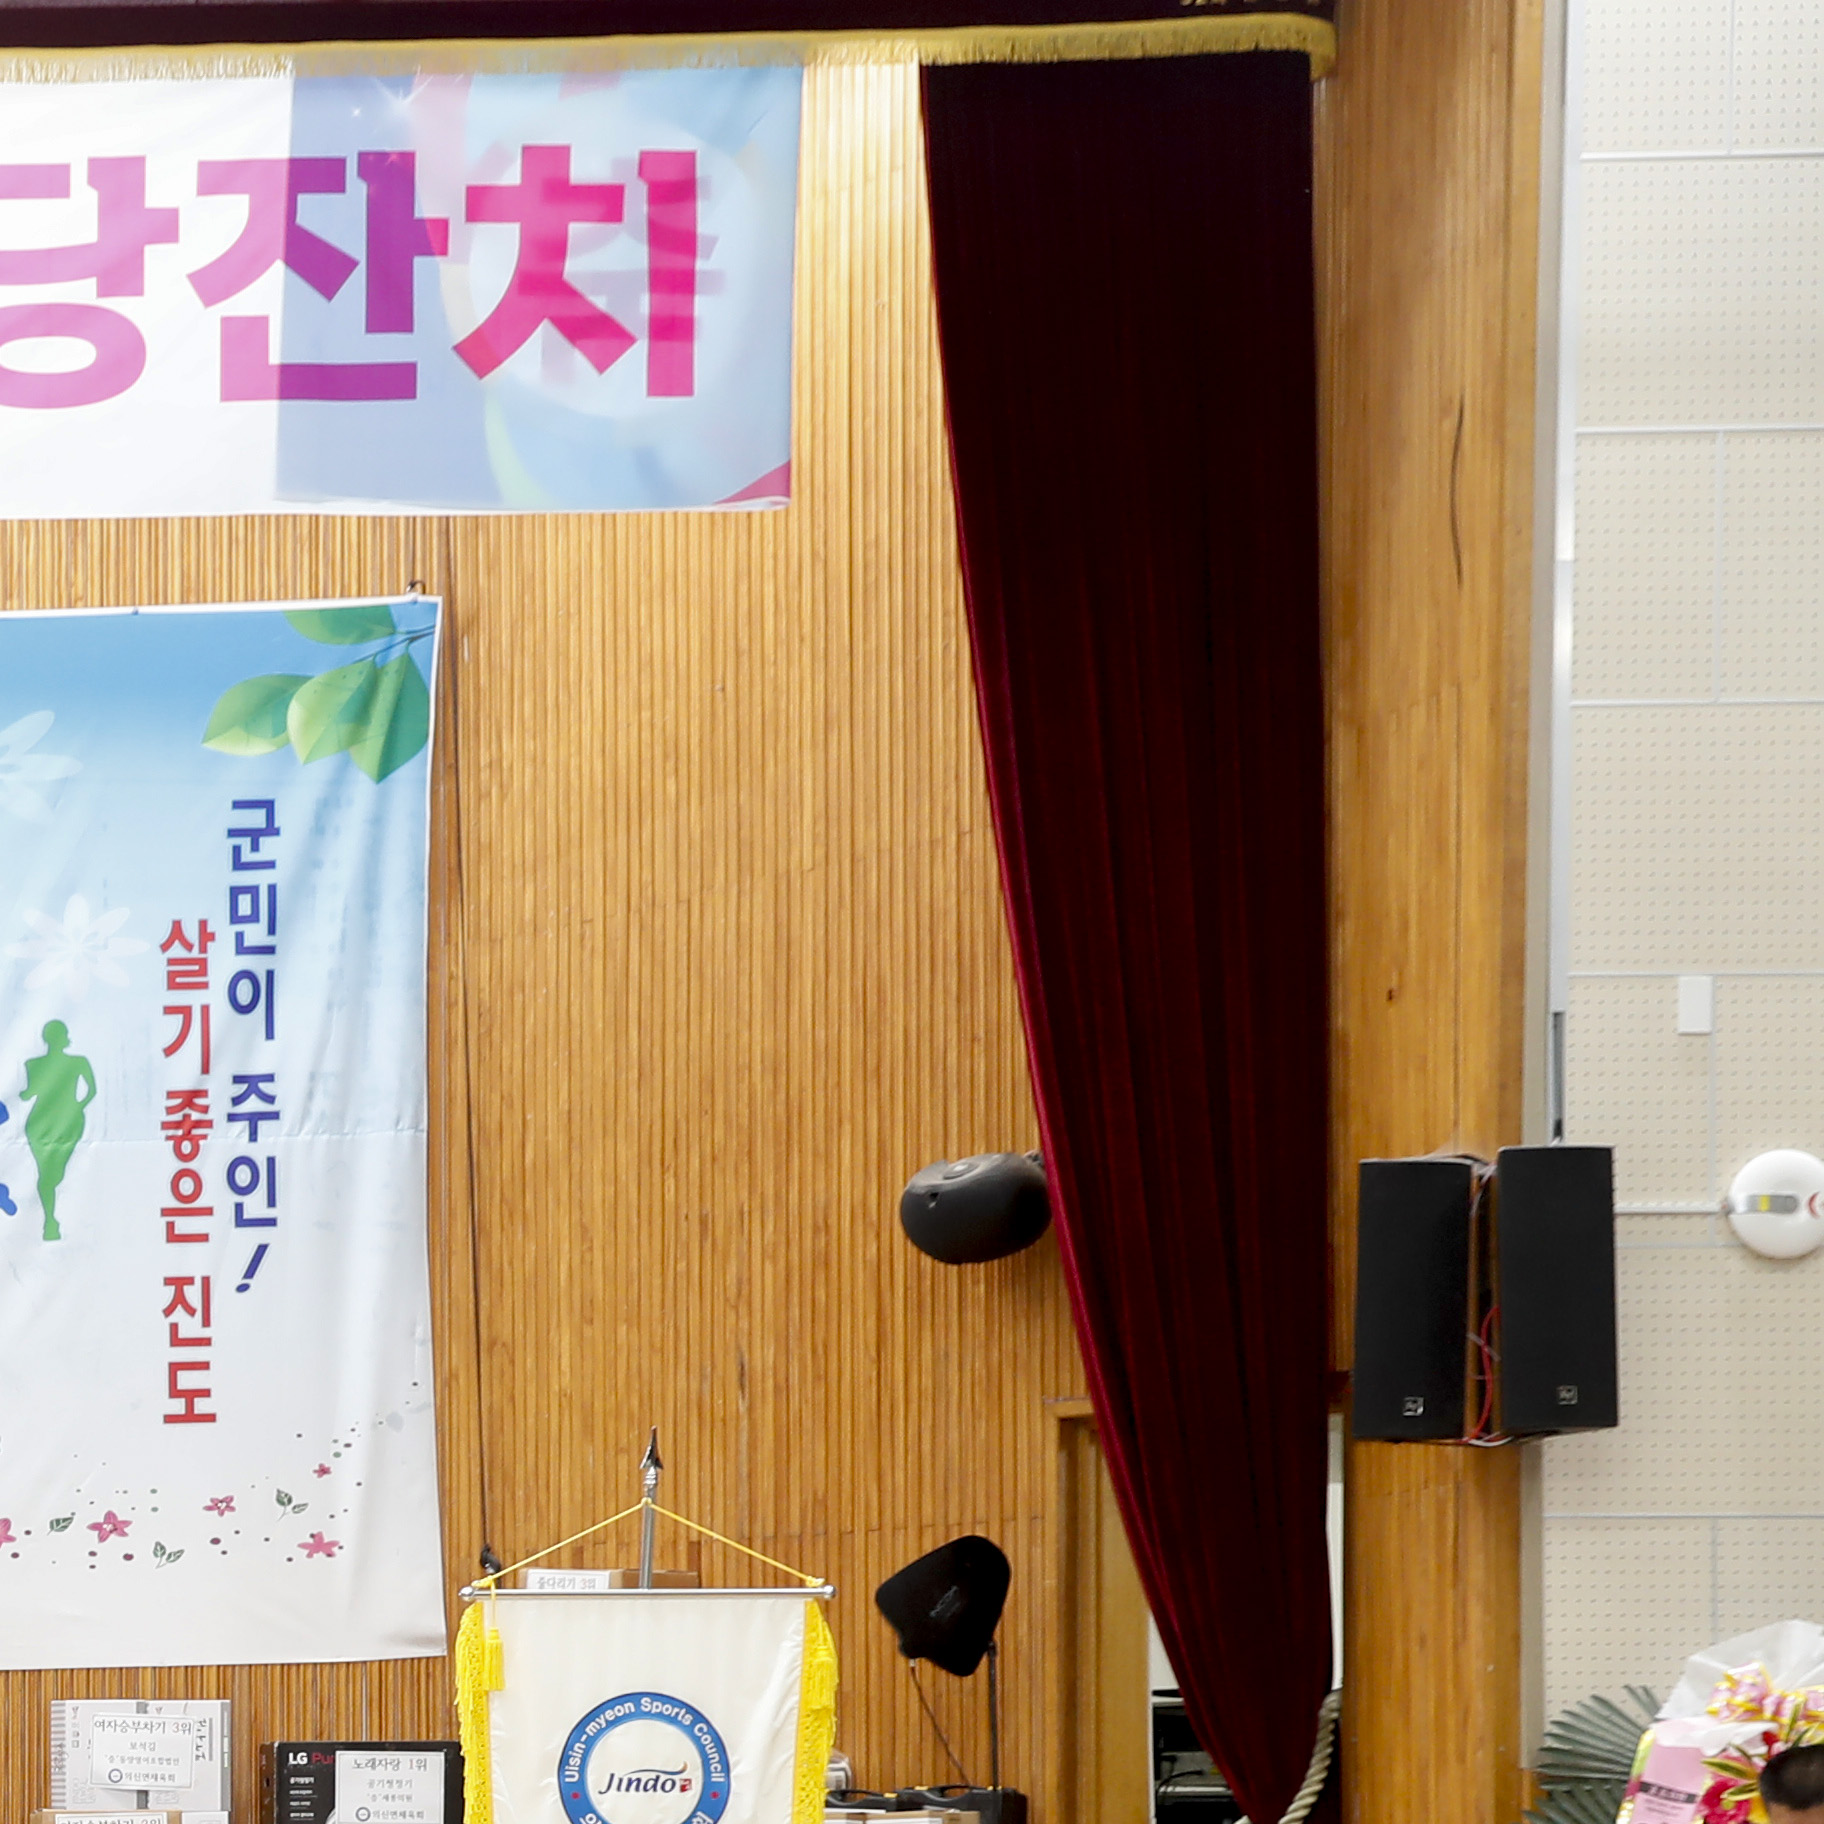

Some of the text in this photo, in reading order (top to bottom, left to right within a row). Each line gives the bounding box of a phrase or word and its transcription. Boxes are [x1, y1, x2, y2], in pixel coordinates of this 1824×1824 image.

[225, 798, 281, 1294] 군민이 주인!
[160, 1274, 218, 1425] 진도
[94, 1718, 193, 1735] 여자승부차기 3위
[564, 1696, 727, 1783] Uisin-myeon Sports Council
[288, 1752, 309, 1765] LG
[352, 1757, 428, 1772] 노래자랑 1위
[597, 1772, 676, 1795] Jindo
